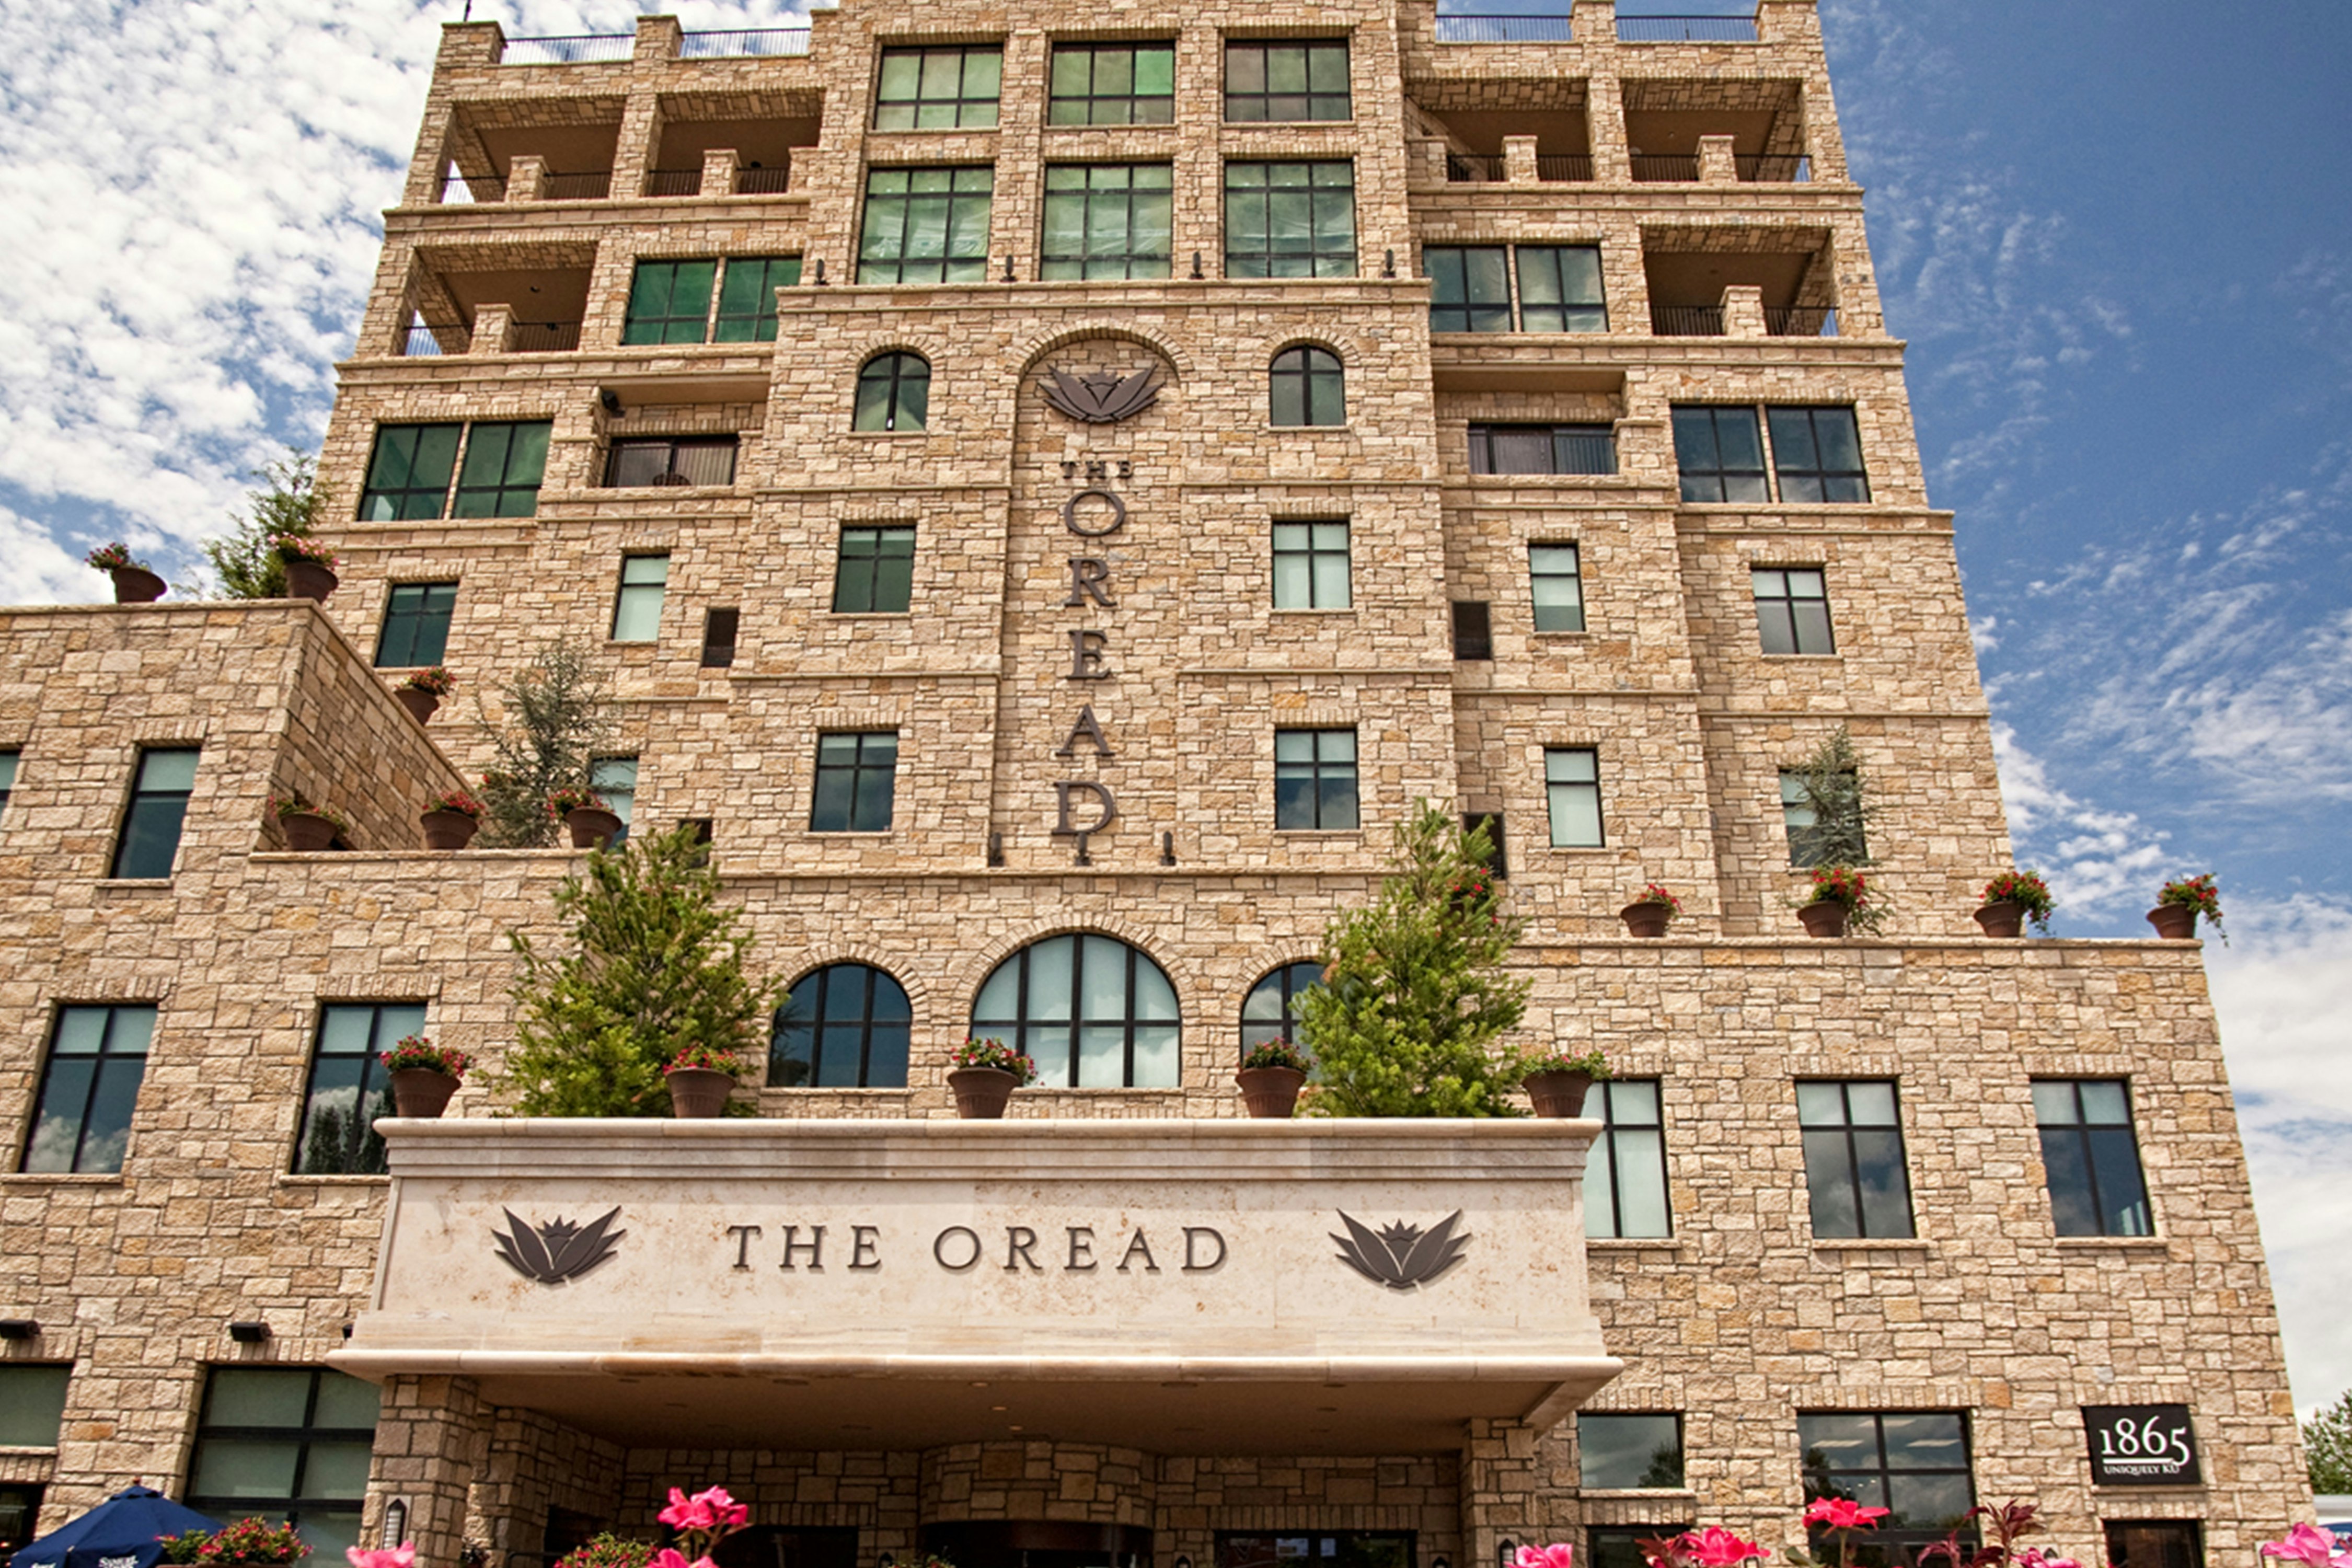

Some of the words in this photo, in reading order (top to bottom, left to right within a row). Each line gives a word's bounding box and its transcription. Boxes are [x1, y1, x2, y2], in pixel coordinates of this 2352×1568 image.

[1059, 460, 1133, 479] THE
[1052, 490, 1126, 835] OREAD
[726, 1225, 883, 1269] THE
[933, 1225, 1228, 1272] OREAD
[2099, 1415, 2190, 1467] 1865
[2103, 1465, 2160, 1476] UNIQUELY
[2162, 1464, 2181, 1474] KU
